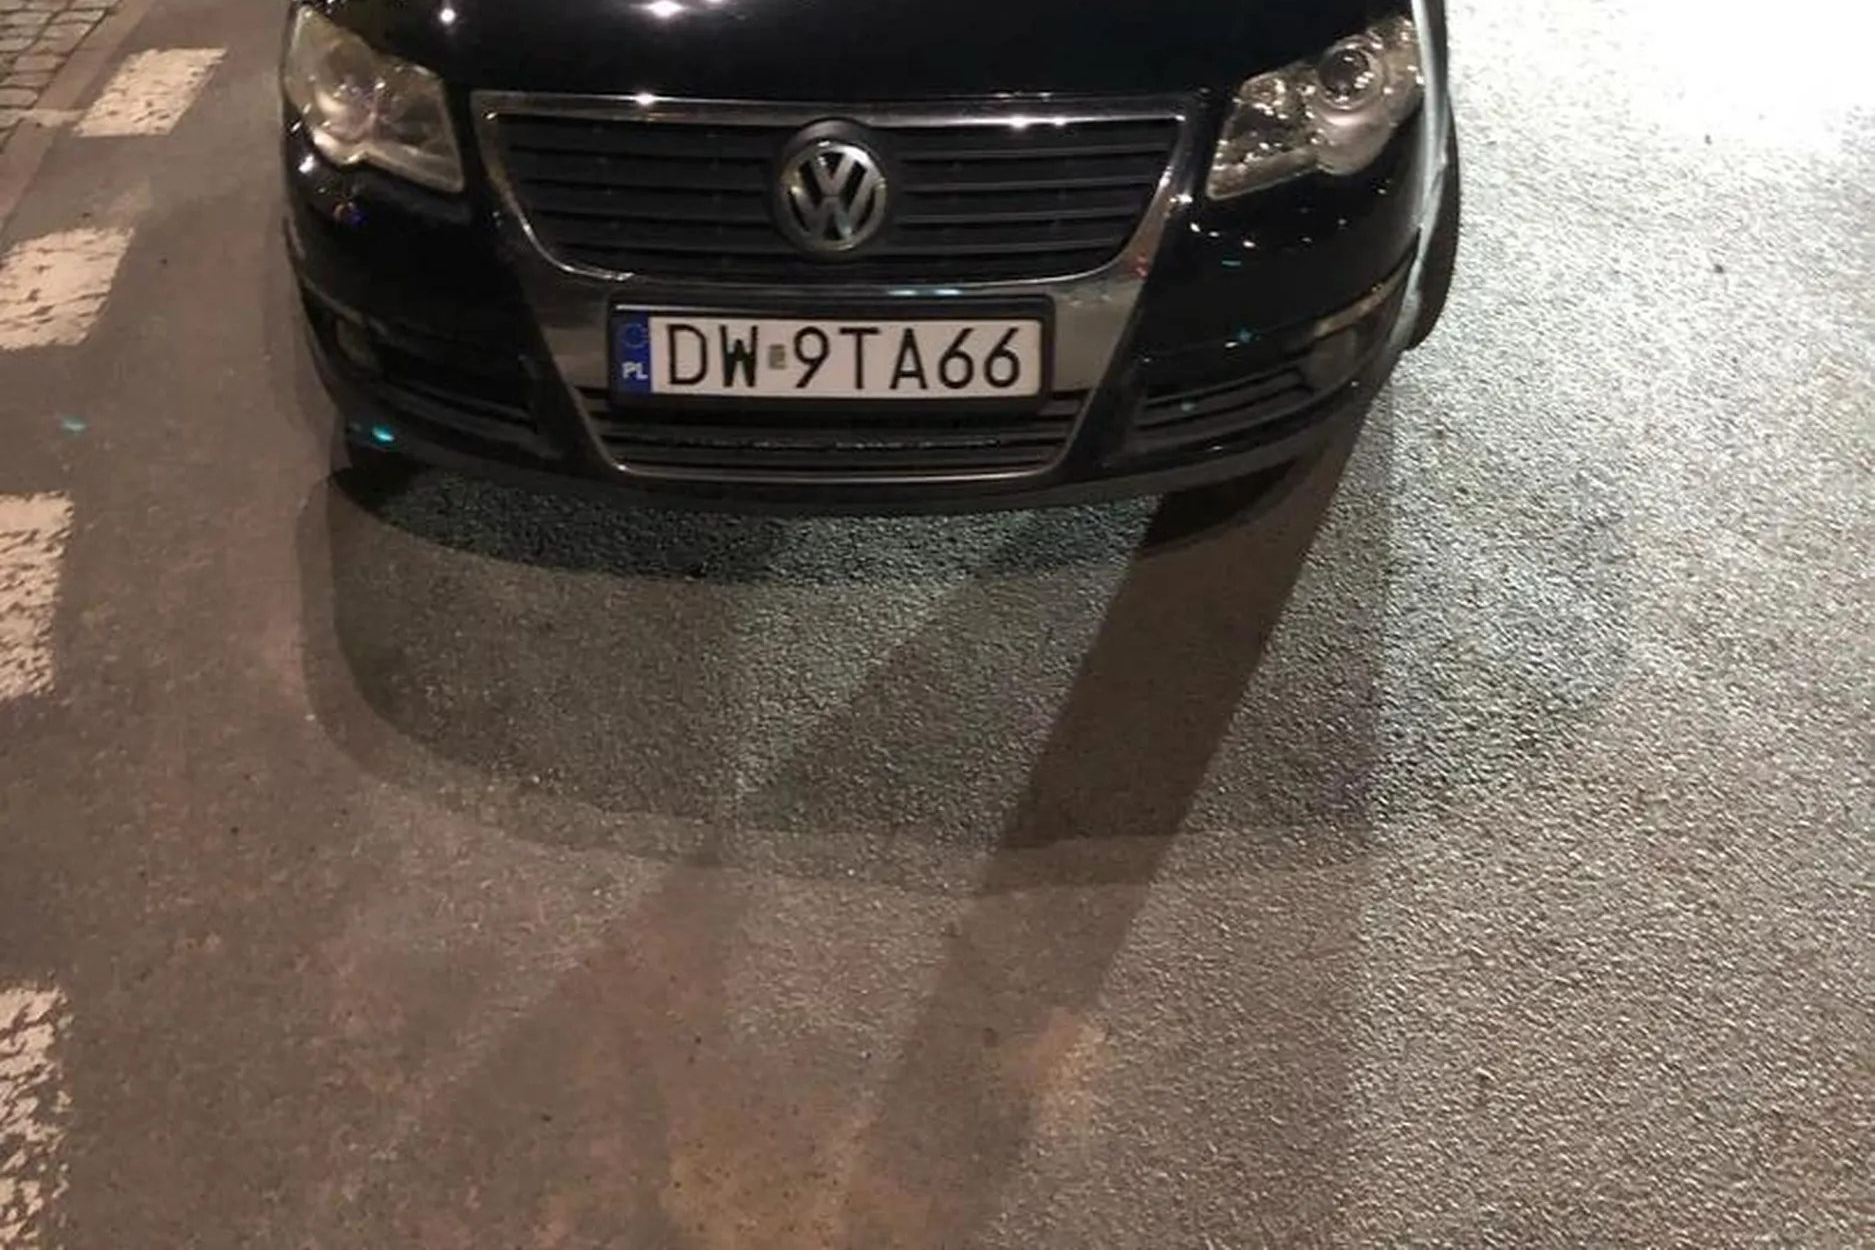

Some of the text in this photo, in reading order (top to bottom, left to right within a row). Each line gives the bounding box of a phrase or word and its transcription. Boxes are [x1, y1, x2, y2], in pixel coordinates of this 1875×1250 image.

[622, 360, 649, 381] PL
[666, 323, 1022, 391] DW 9TA66
